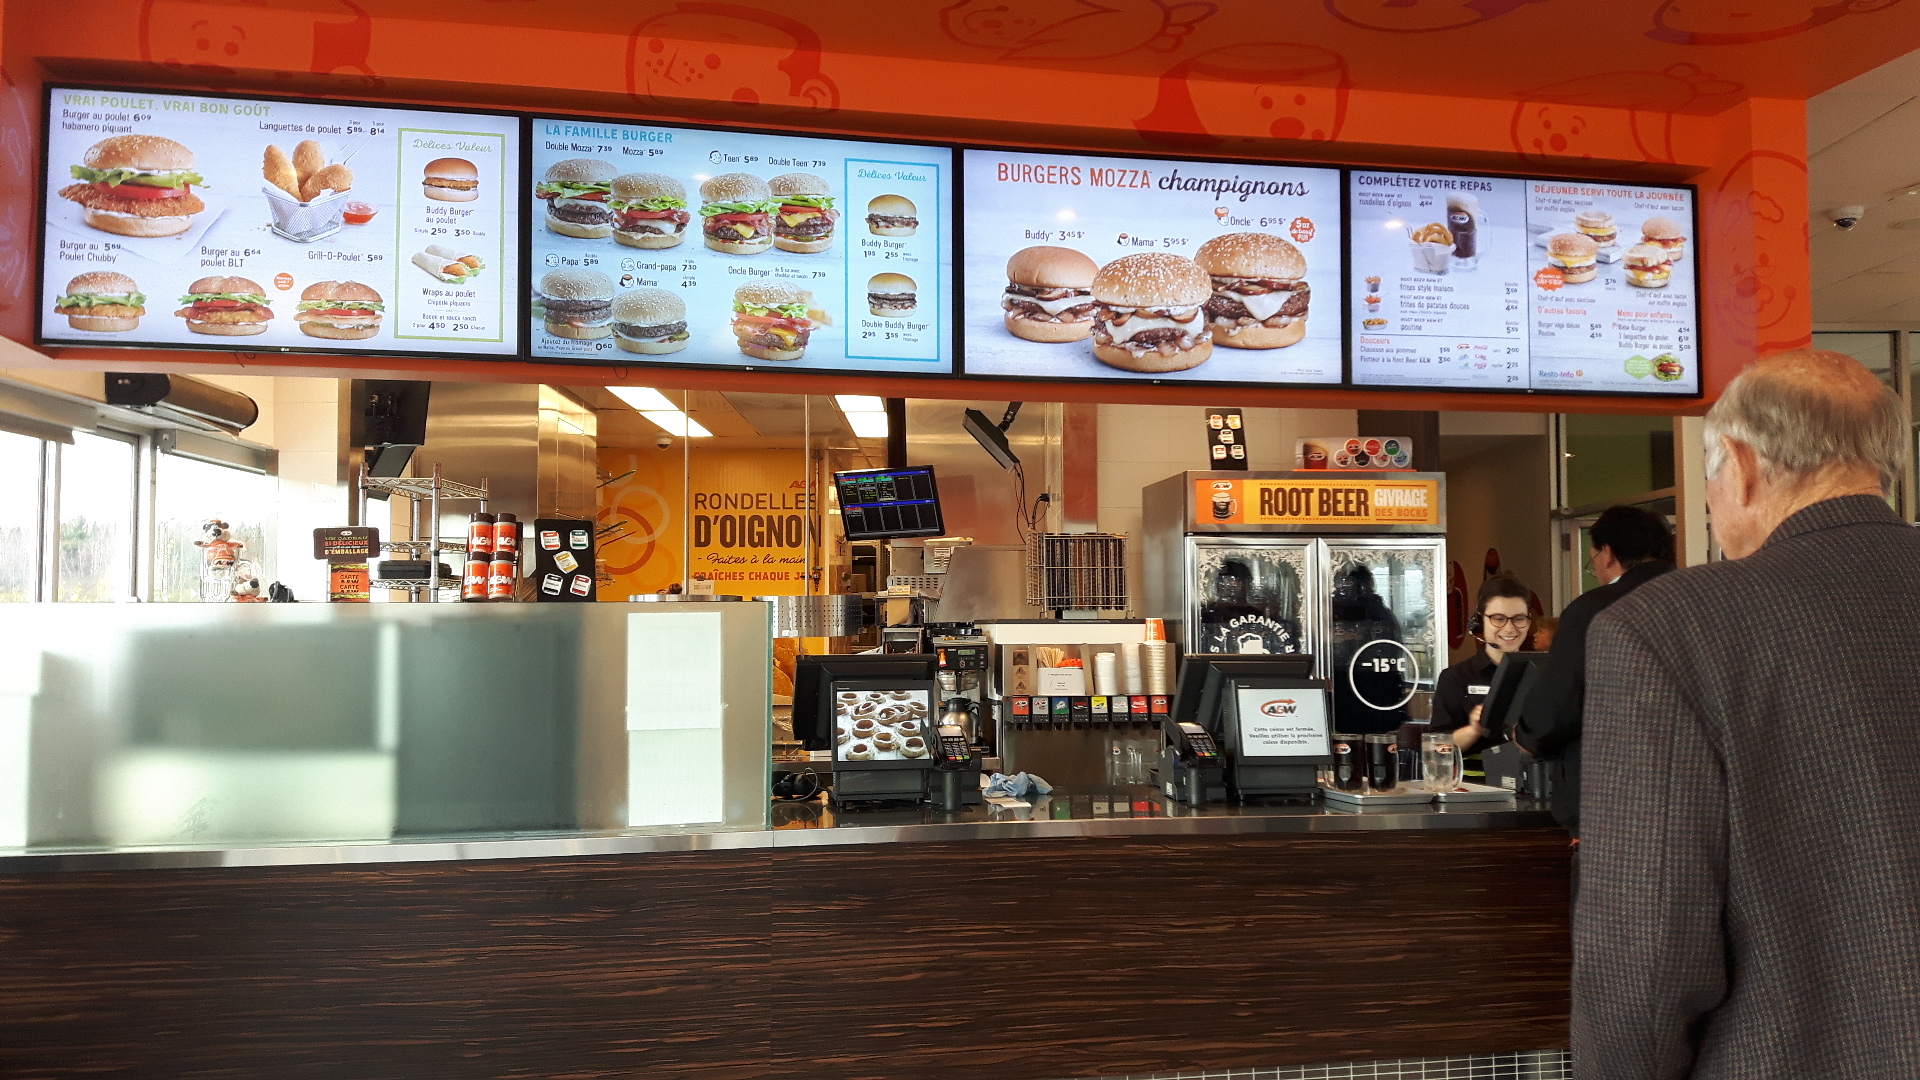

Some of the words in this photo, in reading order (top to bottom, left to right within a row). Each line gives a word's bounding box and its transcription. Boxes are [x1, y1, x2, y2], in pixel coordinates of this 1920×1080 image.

[63, 95, 95, 106] VRAI
[164, 100, 195, 112] VRAI
[200, 102, 229, 114] BON
[62, 109, 90, 120] Burger
[92, 112, 102, 120] au
[105, 112, 130, 123] poulet
[62, 122, 99, 132] habanero
[102, 124, 132, 134] piquant
[259, 121, 303, 134] Languettes
[305, 123, 315, 133] de
[317, 124, 342, 135] poulet
[545, 124, 560, 135] LA
[565, 126, 617, 139] FAMILLE
[622, 130, 672, 143] BURGER
[412, 139, 453, 150] Délices
[455, 141, 492, 153] Valeur
[545, 141, 569, 151] Double
[571, 143, 592, 153] Mozza
[623, 147, 644, 156] Mozza
[724, 154, 739, 163] Teen
[768, 157, 790, 167] Double
[858, 168, 892, 180] Délices
[895, 170, 926, 182] Valeur
[998, 163, 1082, 186] BURGERS
[1090, 168, 1150, 189] MOZZA
[1158, 168, 1310, 202] champignons
[1358, 175, 1421, 188] COMPLÉTEZ
[1424, 179, 1457, 190] VOTRE
[1460, 181, 1492, 192] REPAS
[1534, 185, 1578, 195] DÉJEUNER
[1581, 187, 1605, 196] SERVI
[1607, 189, 1633, 198] TOUTE
[1647, 191, 1685, 202] JOURNÉE
[426, 206, 447, 217] Buddy
[449, 207, 472, 218] Burger
[436, 215, 457, 225] poulet
[1230, 216, 1251, 226] Oncle
[1025, 229, 1050, 241] Buddy
[60, 240, 86, 250] Burger
[862, 239, 881, 248] Buddy
[884, 239, 904, 249] Burger
[1132, 237, 1154, 247] Mama
[60, 251, 84, 261] Poulet
[87, 252, 117, 264] Chubby
[201, 246, 228, 257] Burger
[230, 249, 240, 257] au
[201, 258, 225, 268] poulet
[228, 258, 244, 268] BLT
[561, 257, 579, 266] Papa
[636, 261, 676, 272] Grand-papa
[728, 266, 746, 275] Oncle
[748, 268, 770, 277] Burger
[637, 278, 657, 286] Mama
[422, 288, 443, 298] Wraps
[455, 289, 476, 299] poulet
[862, 319, 883, 329] Double
[885, 320, 905, 330] Buddy
[907, 321, 928, 330] Burger
[694, 492, 817, 510] RONDELLES
[1260, 488, 1314, 517] ROOT
[1318, 488, 1370, 517] BEER
[1374, 488, 1428, 507] GIVRAGE
[1375, 508, 1393, 517] DES
[1397, 509, 1428, 517] BOCKS
[694, 514, 821, 548] D'OIGNON
[706, 552, 748, 565] Faites
[750, 554, 759, 564] à
[763, 554, 776, 564] la
[779, 555, 806, 564] main
[749, 572, 790, 581] CHAQUE
[1214, 625, 1230, 643] LA
[1229, 614, 1290, 642] GARANTIE
[1267, 705, 1297, 715] A&W
